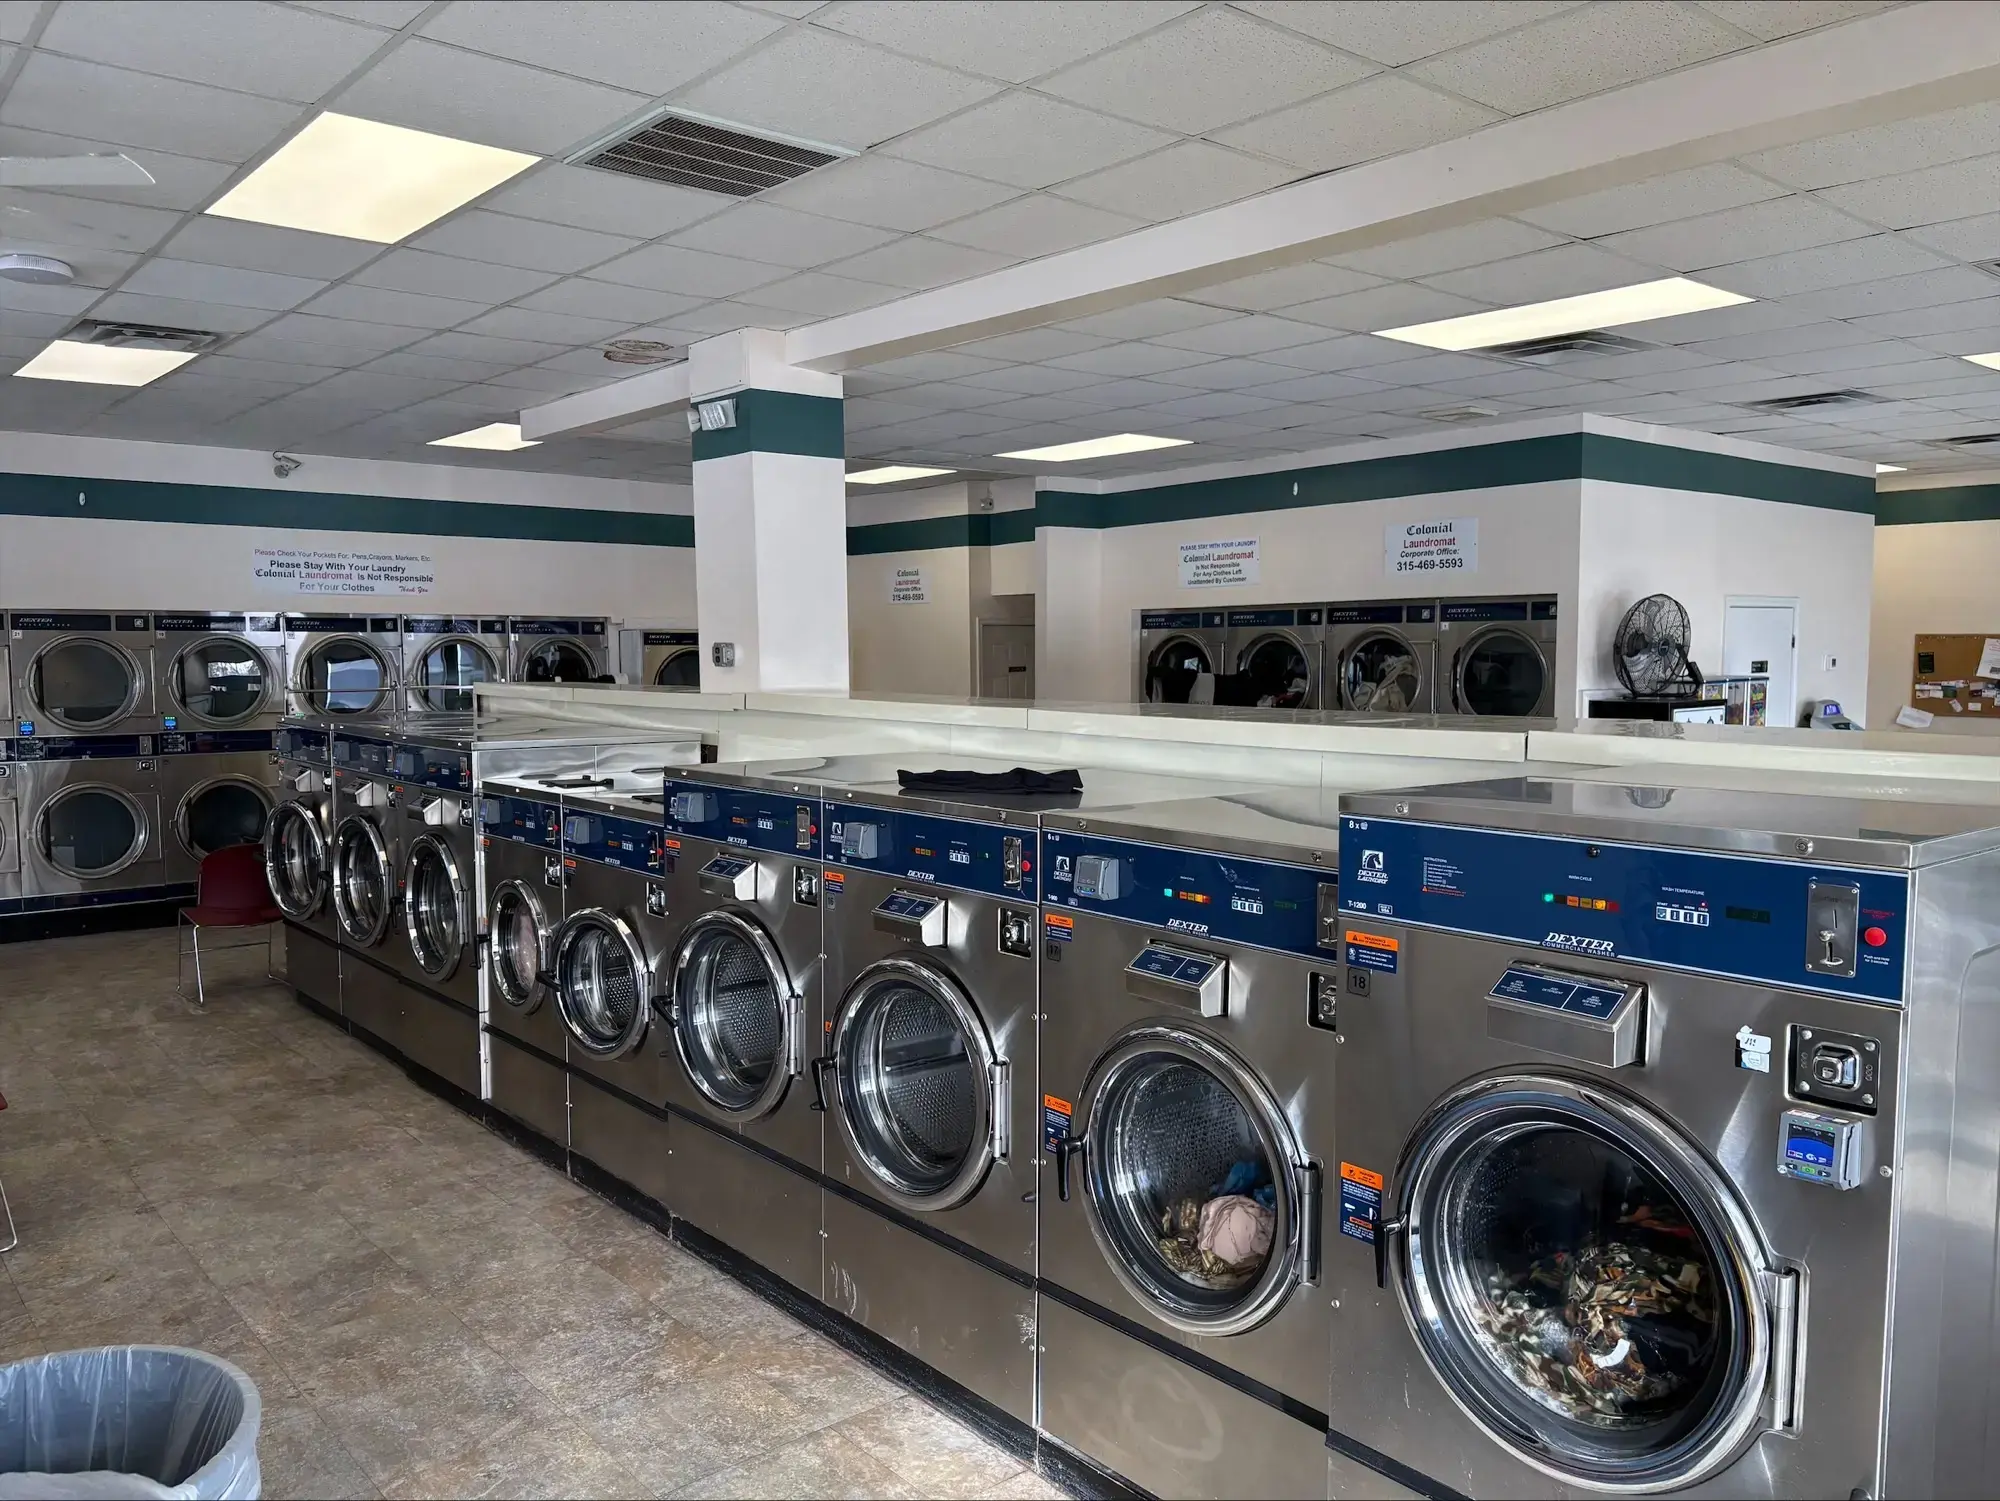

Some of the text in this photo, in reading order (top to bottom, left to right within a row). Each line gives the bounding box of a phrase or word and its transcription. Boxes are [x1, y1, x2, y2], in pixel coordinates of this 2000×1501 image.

[1407, 522, 1452, 536] Colonial
[1404, 537, 1456, 548] Laundromat
[1184, 551, 1254, 563] Colonial Laundromat
[1400, 550, 1434, 558] Corporate
[270, 560, 406, 574] Please Stay With Your Laundry
[1397, 558, 1463, 571] 315-469-5593
[255, 569, 296, 578] Colonial
[300, 570, 352, 580] Laundromat
[367, 573, 381, 581] Not
[384, 574, 433, 583] Responsible
[300, 582, 316, 590] For
[342, 583, 375, 592] Clothes
[1349, 820, 1354, 828] 8
[727, 836, 747, 844] DEXTER
[907, 870, 934, 880] DEXTER
[1358, 870, 1388, 878] DEXTER
[1357, 876, 1388, 884] LAUNDRY
[1674, 888, 1704, 896] TEMPERATURE
[1348, 900, 1366, 909] T-1200
[1167, 918, 1208, 933] DEXTER
[1545, 932, 1614, 951] DEXTER
[1542, 941, 1615, 957] COMMERCIAL WASHER
[1353, 976, 1366, 989] 18
